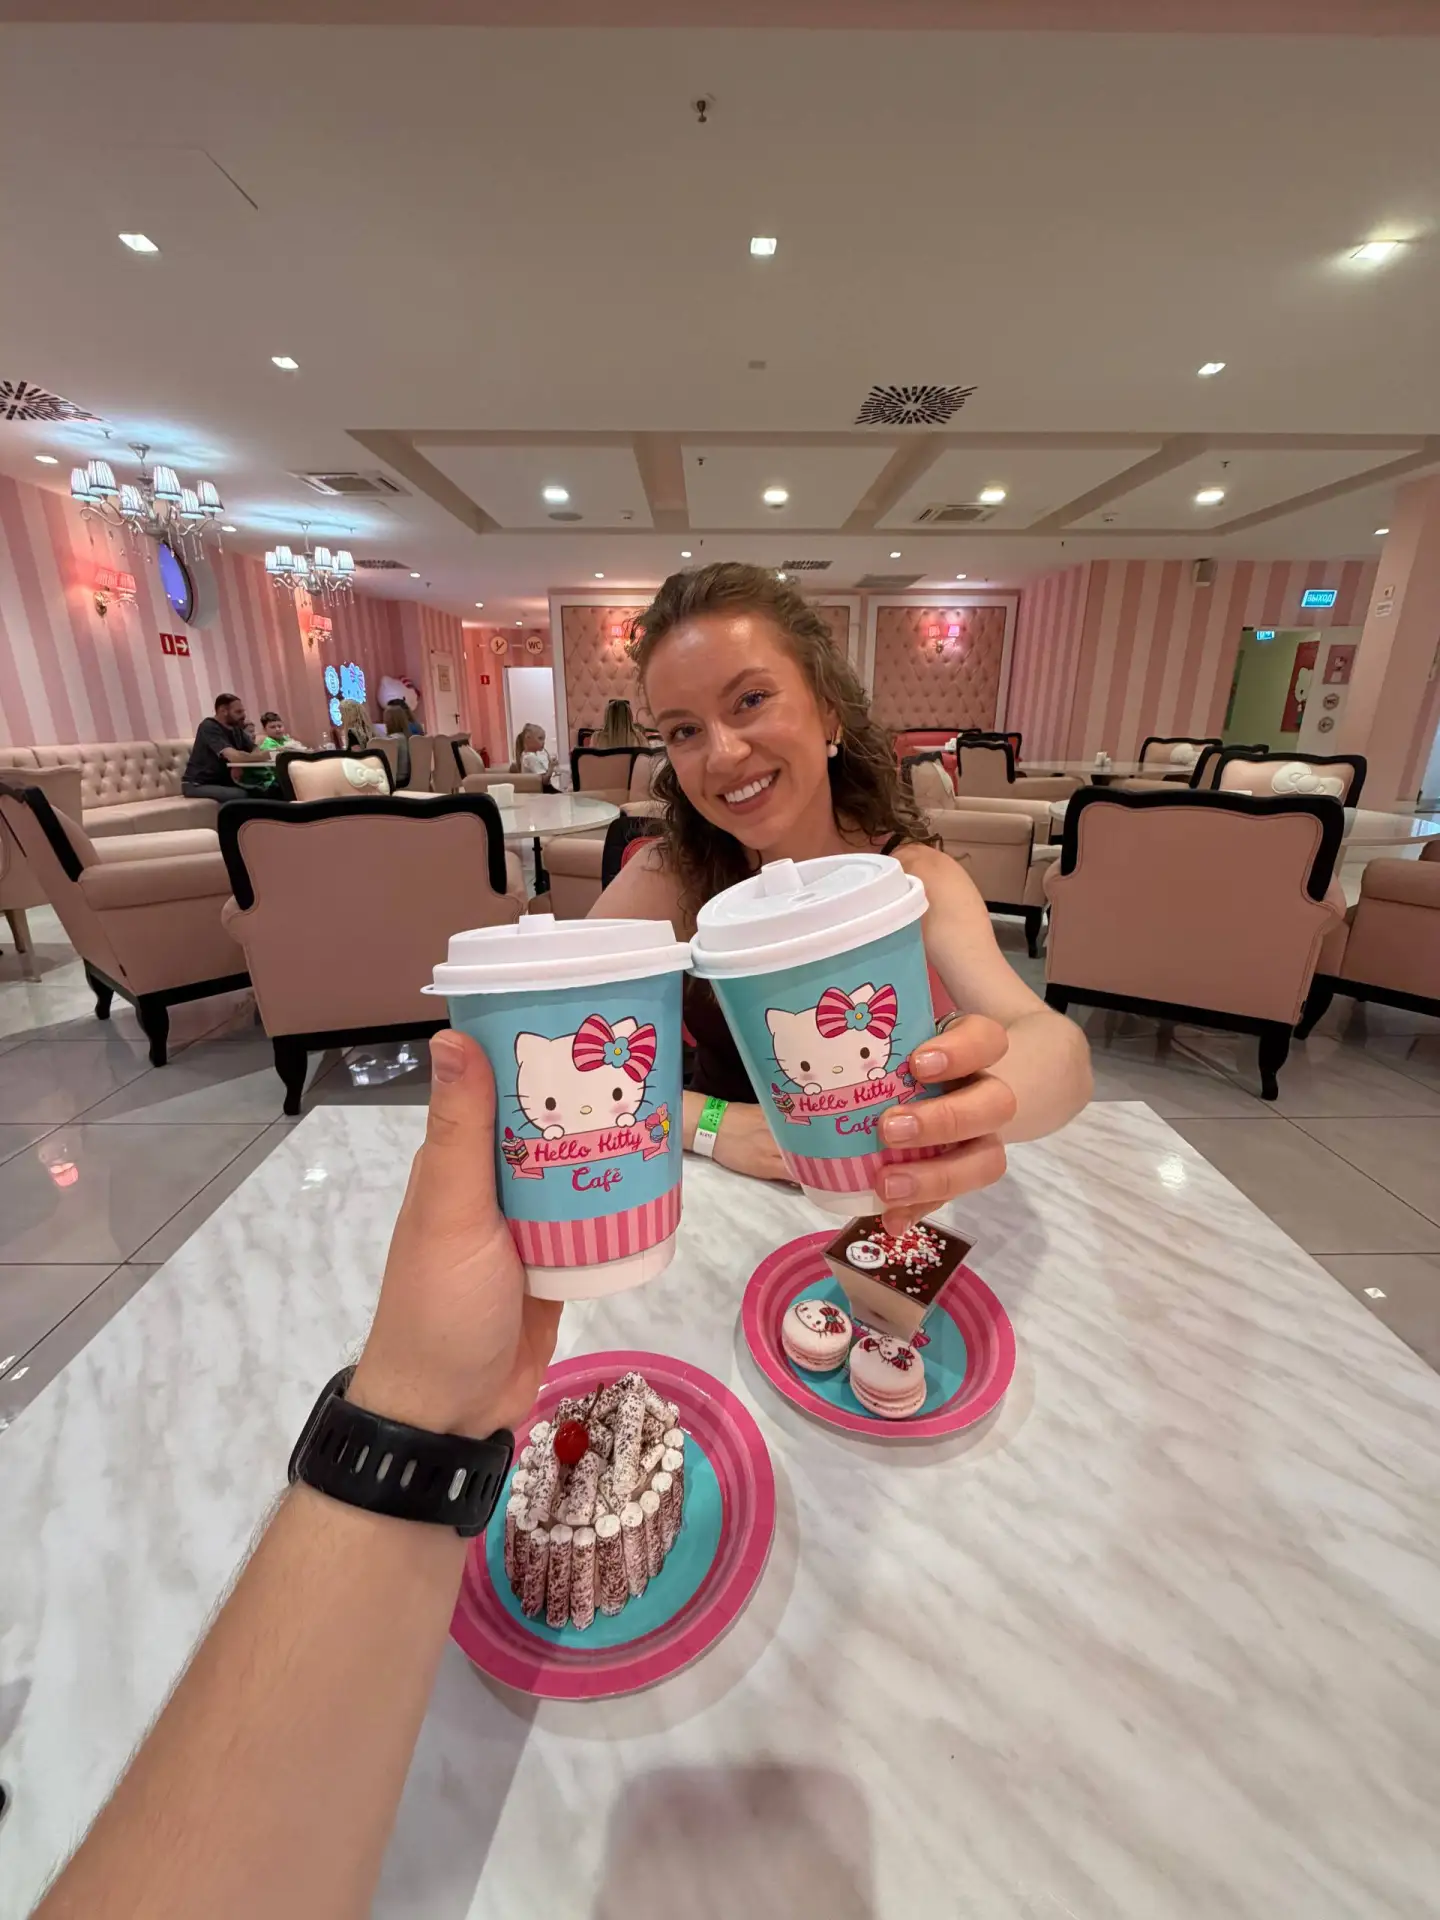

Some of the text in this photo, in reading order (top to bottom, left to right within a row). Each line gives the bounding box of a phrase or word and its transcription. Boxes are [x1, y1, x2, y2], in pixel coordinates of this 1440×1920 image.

[1307, 594, 1332, 603] ВЫХОД
[528, 641, 541, 649] WC
[798, 1079, 895, 1112] Hello Kitty
[534, 1127, 643, 1162] Hello Kitty
[571, 1166, 623, 1192] Café
